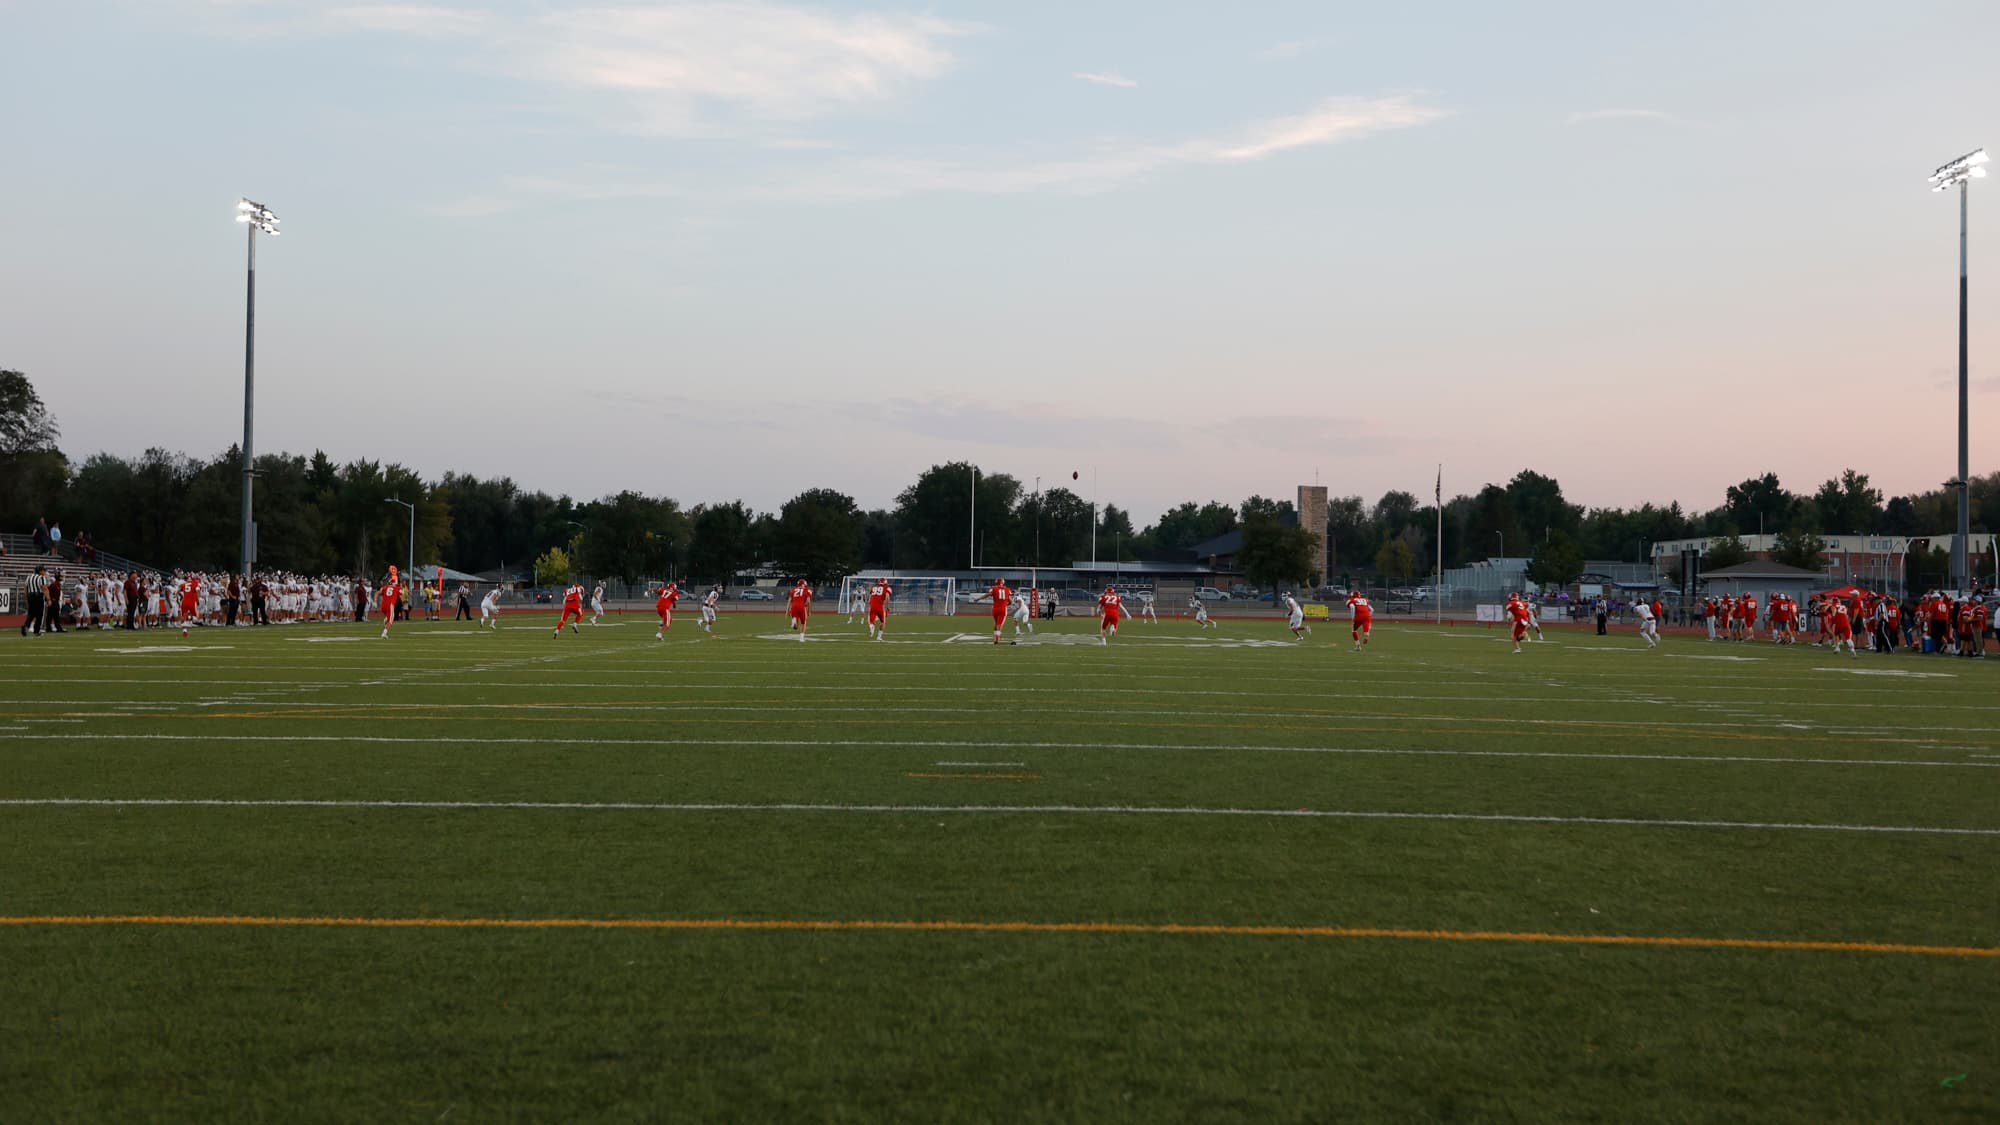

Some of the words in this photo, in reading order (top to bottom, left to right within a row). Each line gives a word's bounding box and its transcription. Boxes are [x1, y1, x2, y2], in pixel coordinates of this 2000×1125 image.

[185, 582, 192, 592] 5
[386, 587, 393, 597] 6
[662, 589, 672, 598] 17
[793, 588, 803, 597] 21
[998, 589, 1006, 600] 11
[1105, 595, 1117, 604] 22
